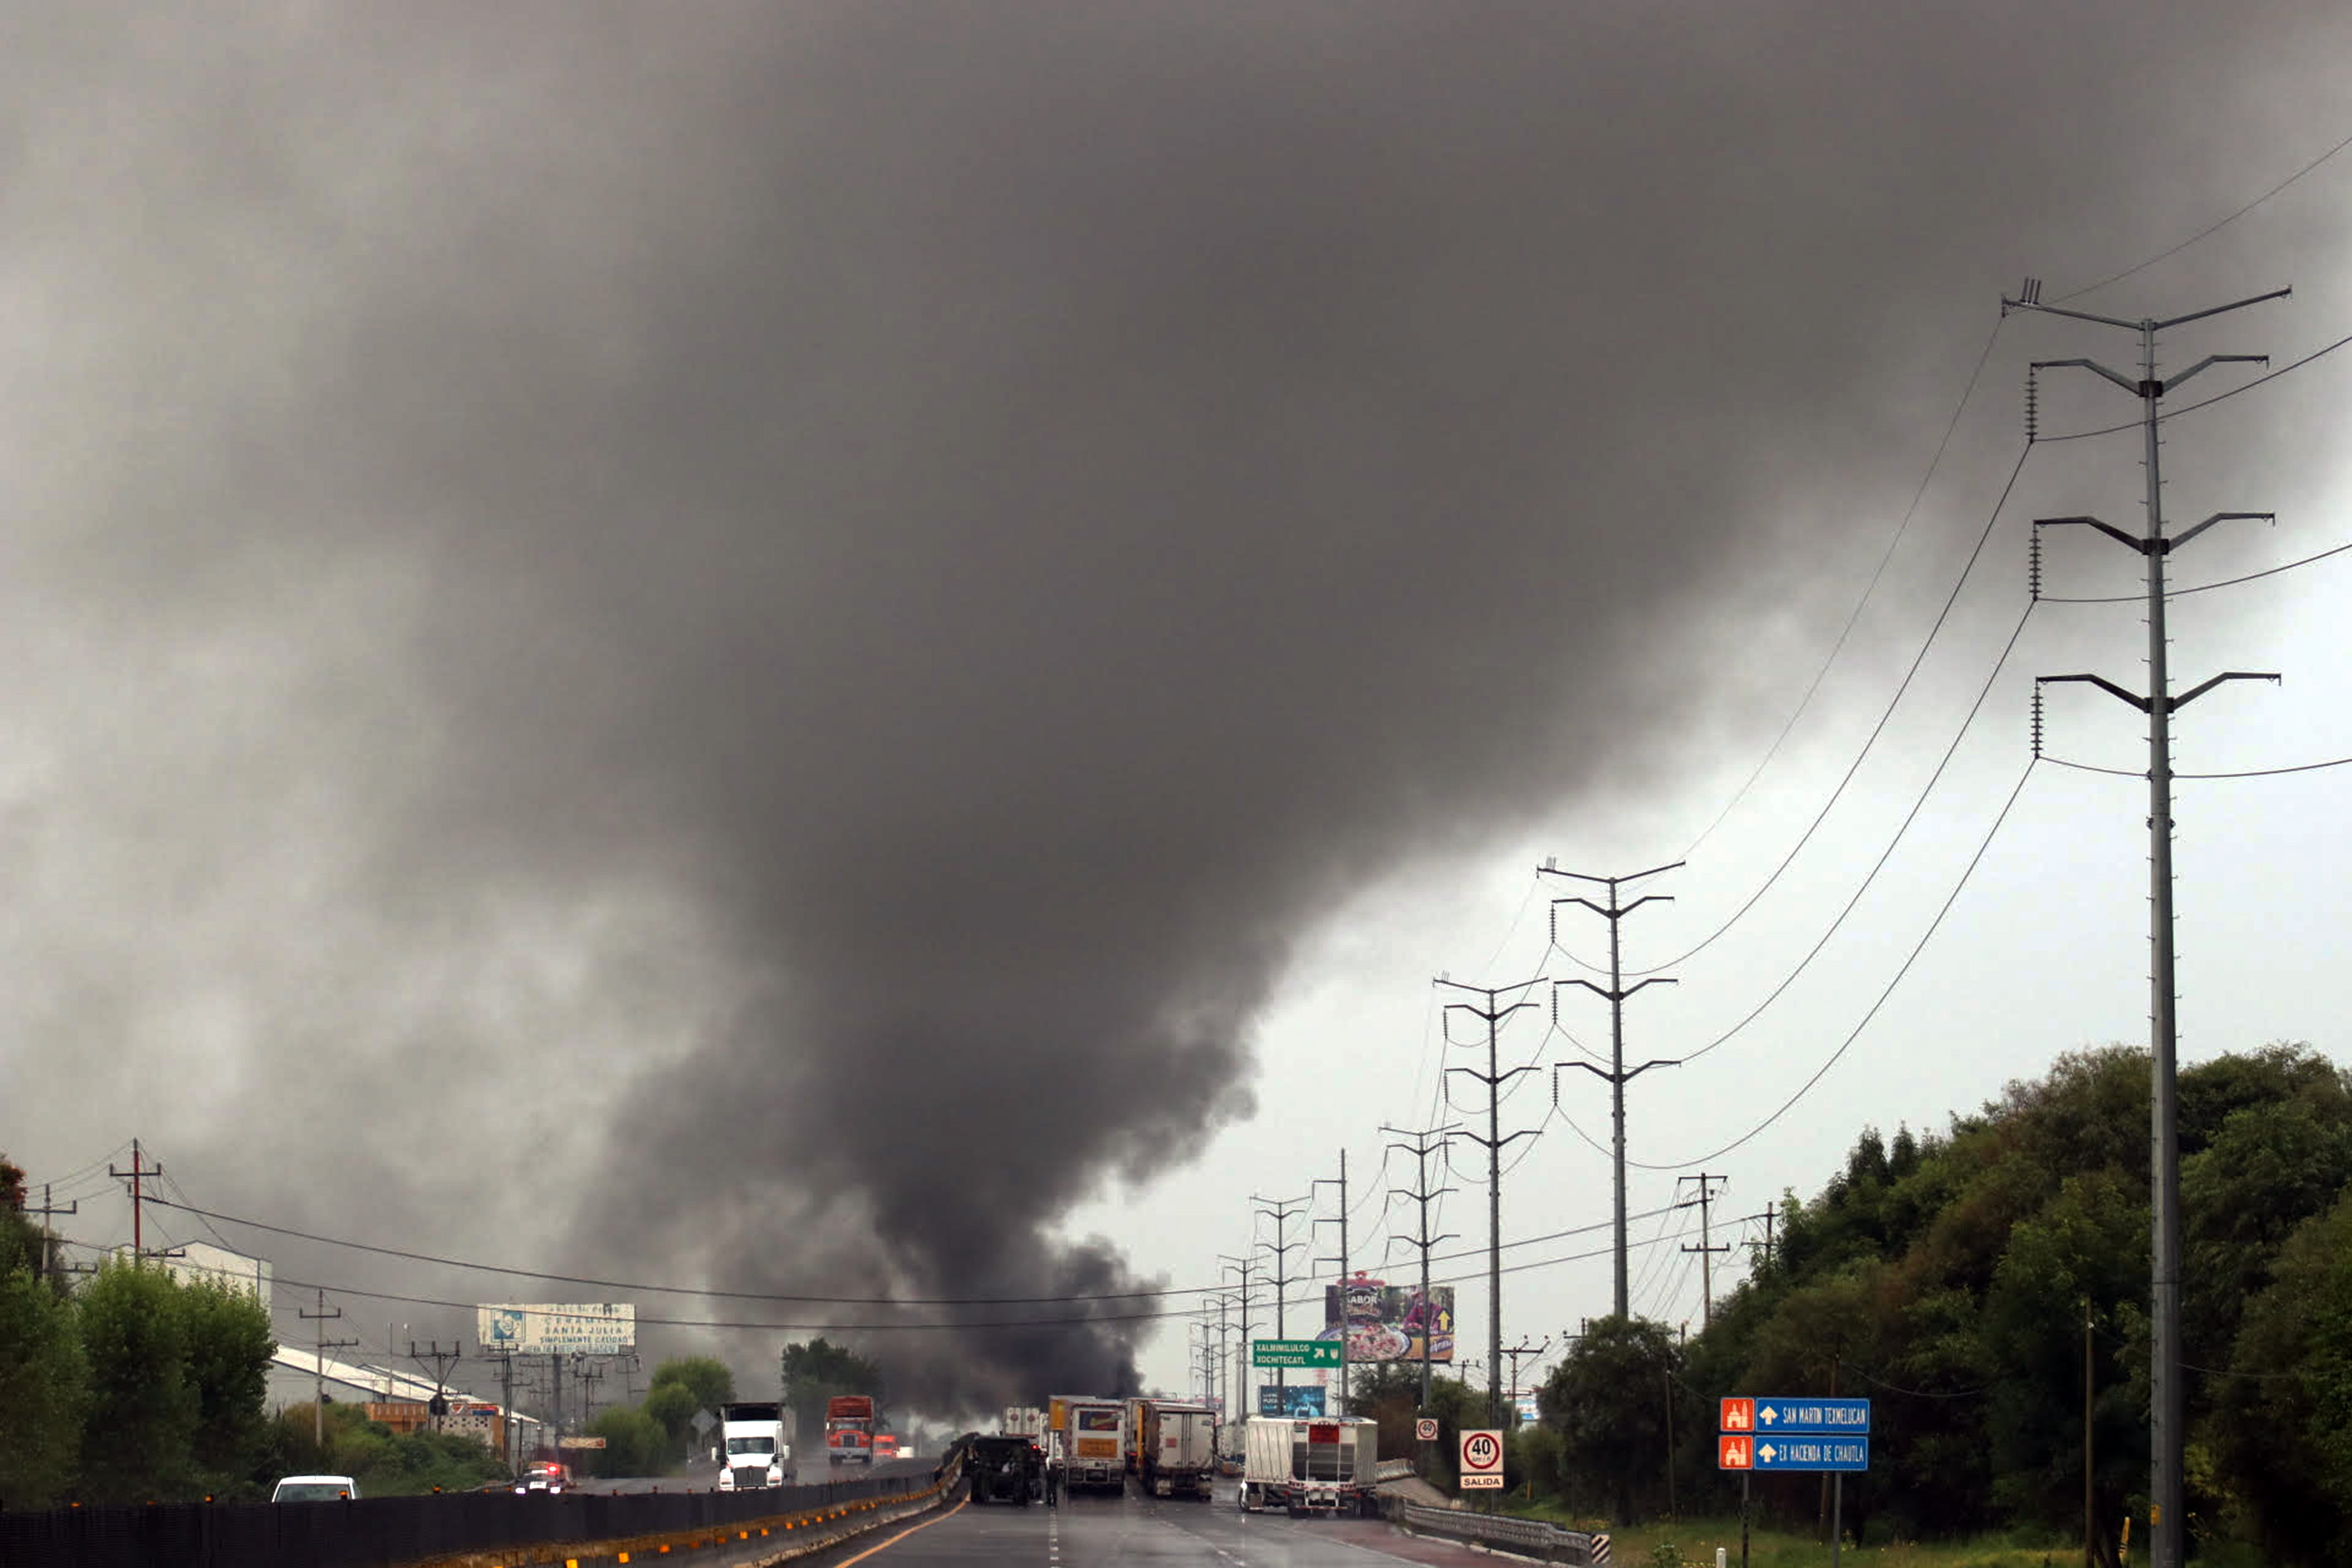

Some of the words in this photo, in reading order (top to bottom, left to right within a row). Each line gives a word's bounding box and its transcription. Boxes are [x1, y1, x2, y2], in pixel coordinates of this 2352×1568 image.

[1347, 1295, 1377, 1304] ABOR
[1256, 1356, 1307, 1364] XOCHITECATL
[1783, 1406, 1797, 1424] SAN
[1799, 1406, 1822, 1425] MARTIN
[1824, 1407, 1866, 1425] TEXMELUCAN
[1422, 1423, 1432, 1432] 40
[1472, 1439, 1490, 1455] 40
[1779, 1444, 1788, 1461] EX
[1824, 1445, 1832, 1462] DE
[1835, 1445, 1864, 1462] CHAUTLA
[1464, 1478, 1500, 1486] SALIDA
